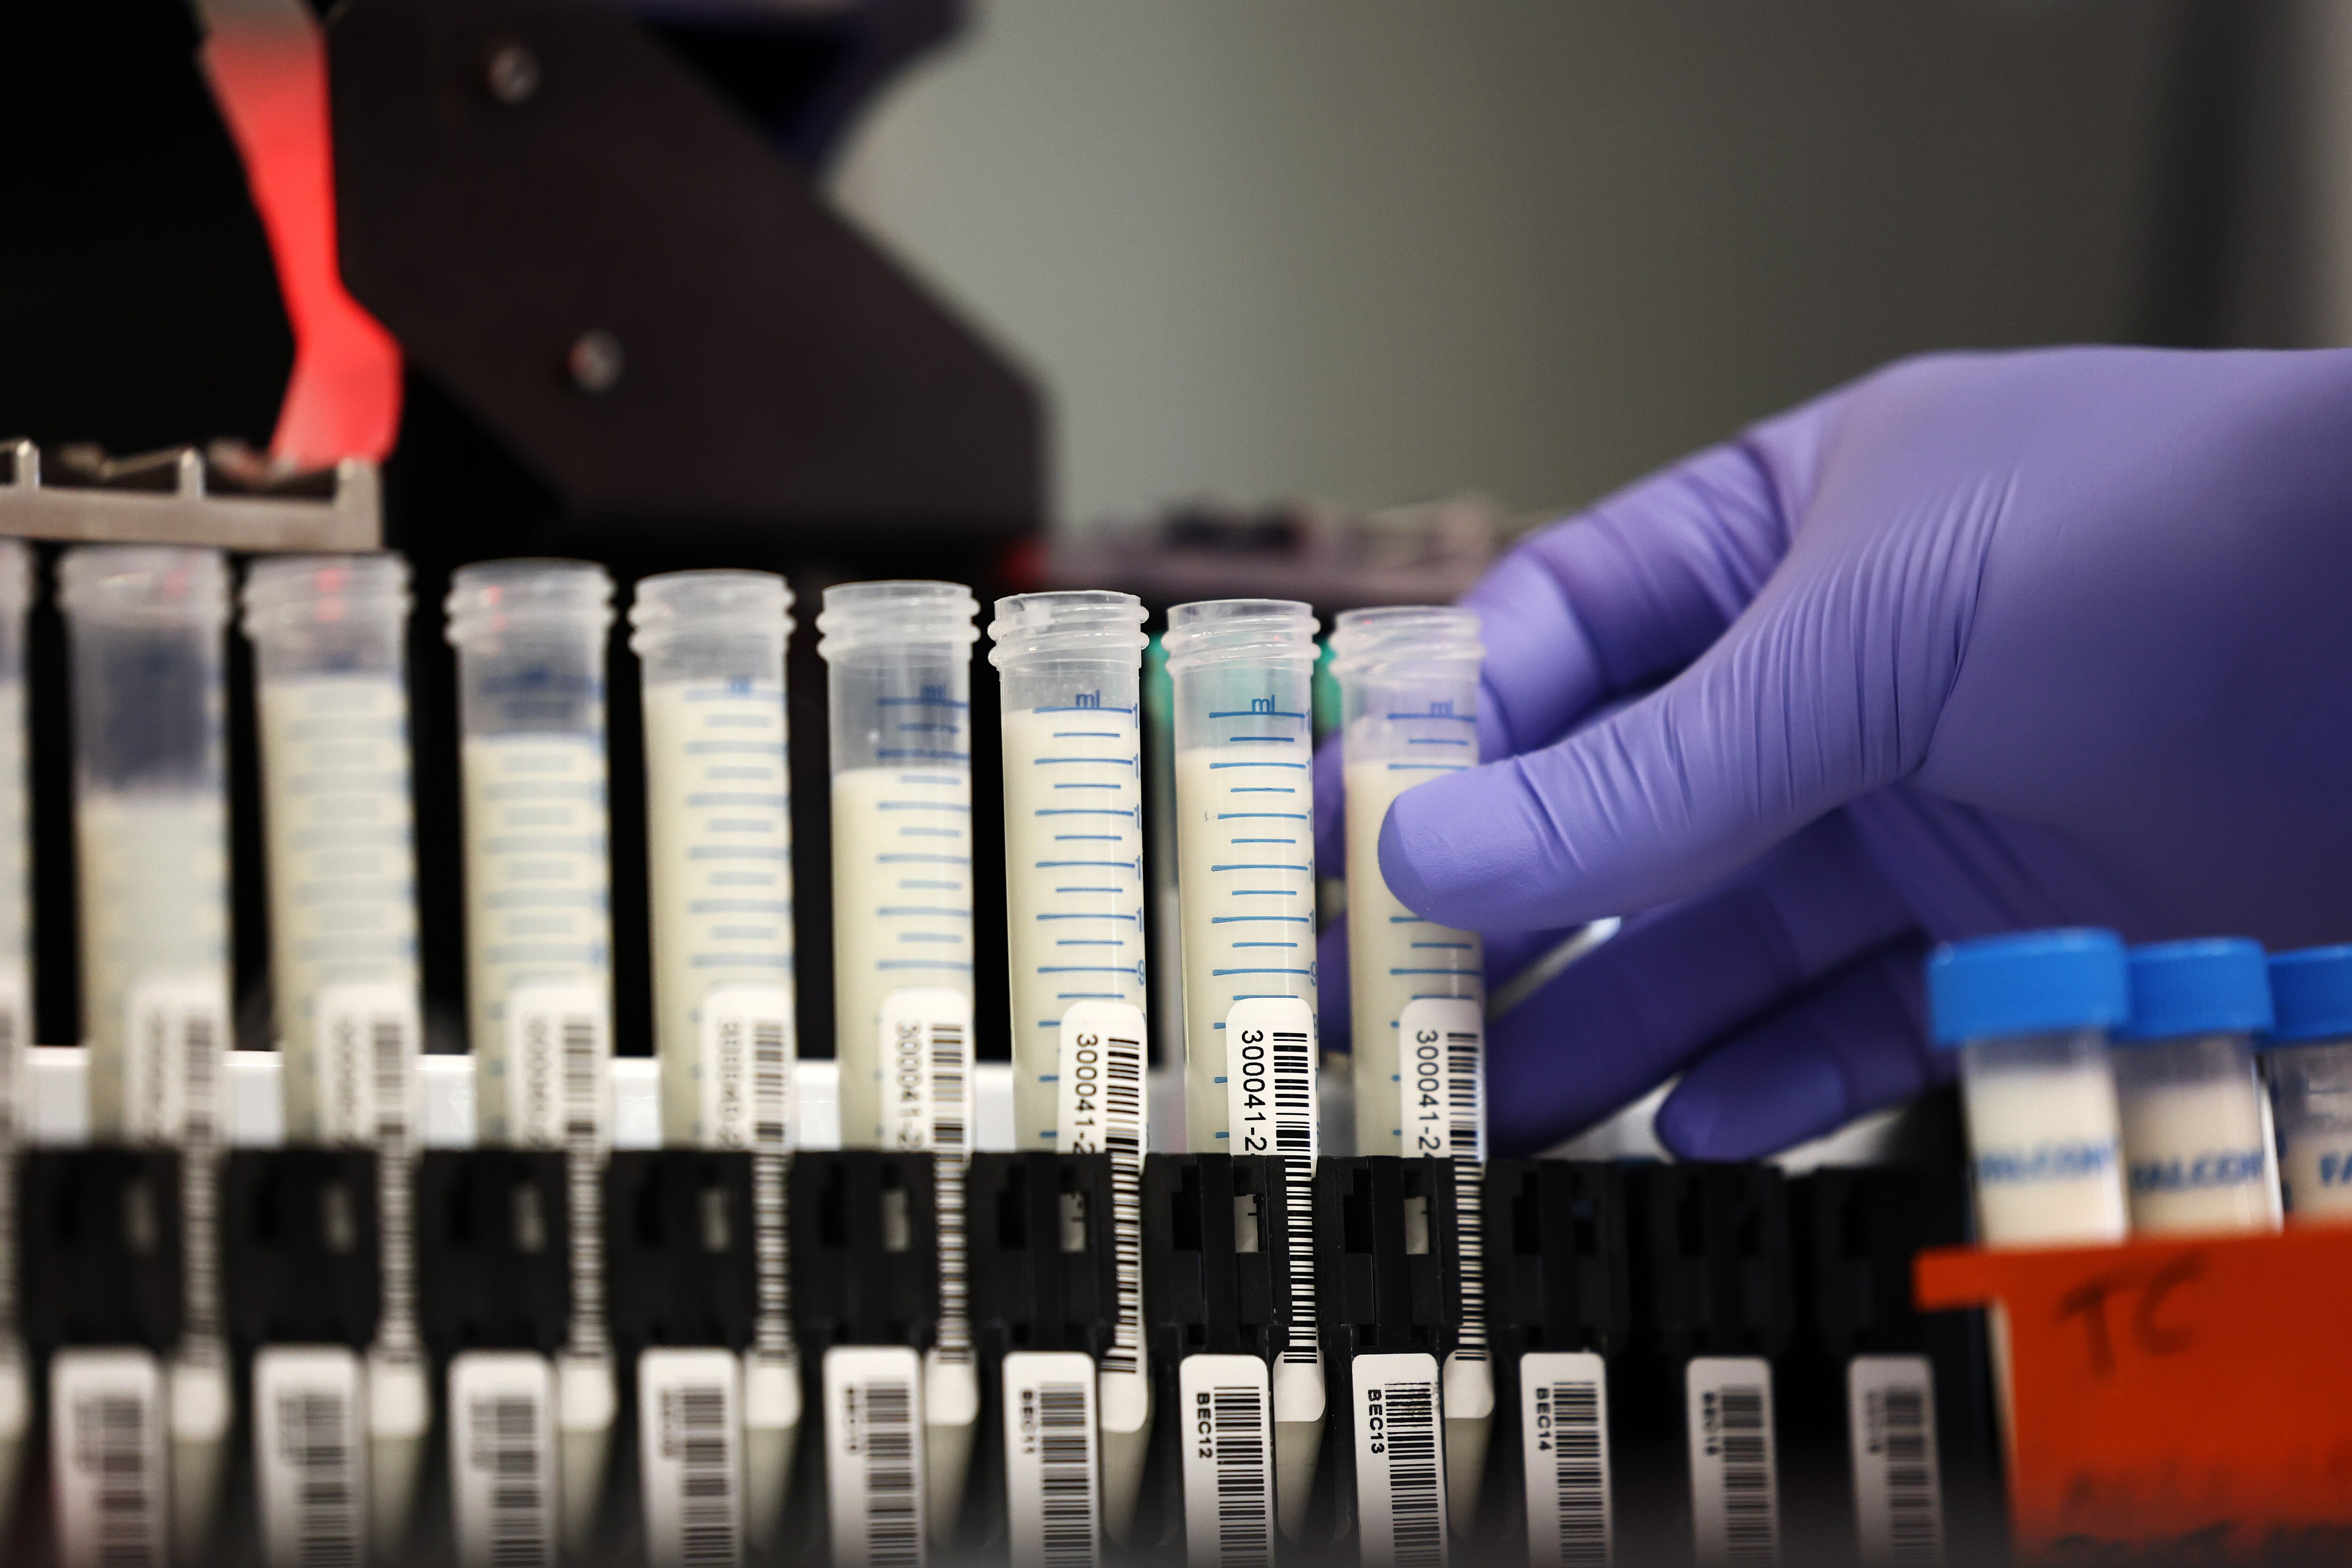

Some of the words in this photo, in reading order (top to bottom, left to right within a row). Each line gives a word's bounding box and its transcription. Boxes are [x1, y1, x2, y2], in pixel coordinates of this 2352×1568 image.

[1075, 690, 1100, 708] ml
[1252, 694, 1275, 713] ml
[1241, 1030, 1267, 1156] 300041-2
[1196, 1393, 1212, 1459] BEC12
[1367, 1389, 1385, 1454] BEC13
[1535, 1387, 1552, 1451] BEC14
